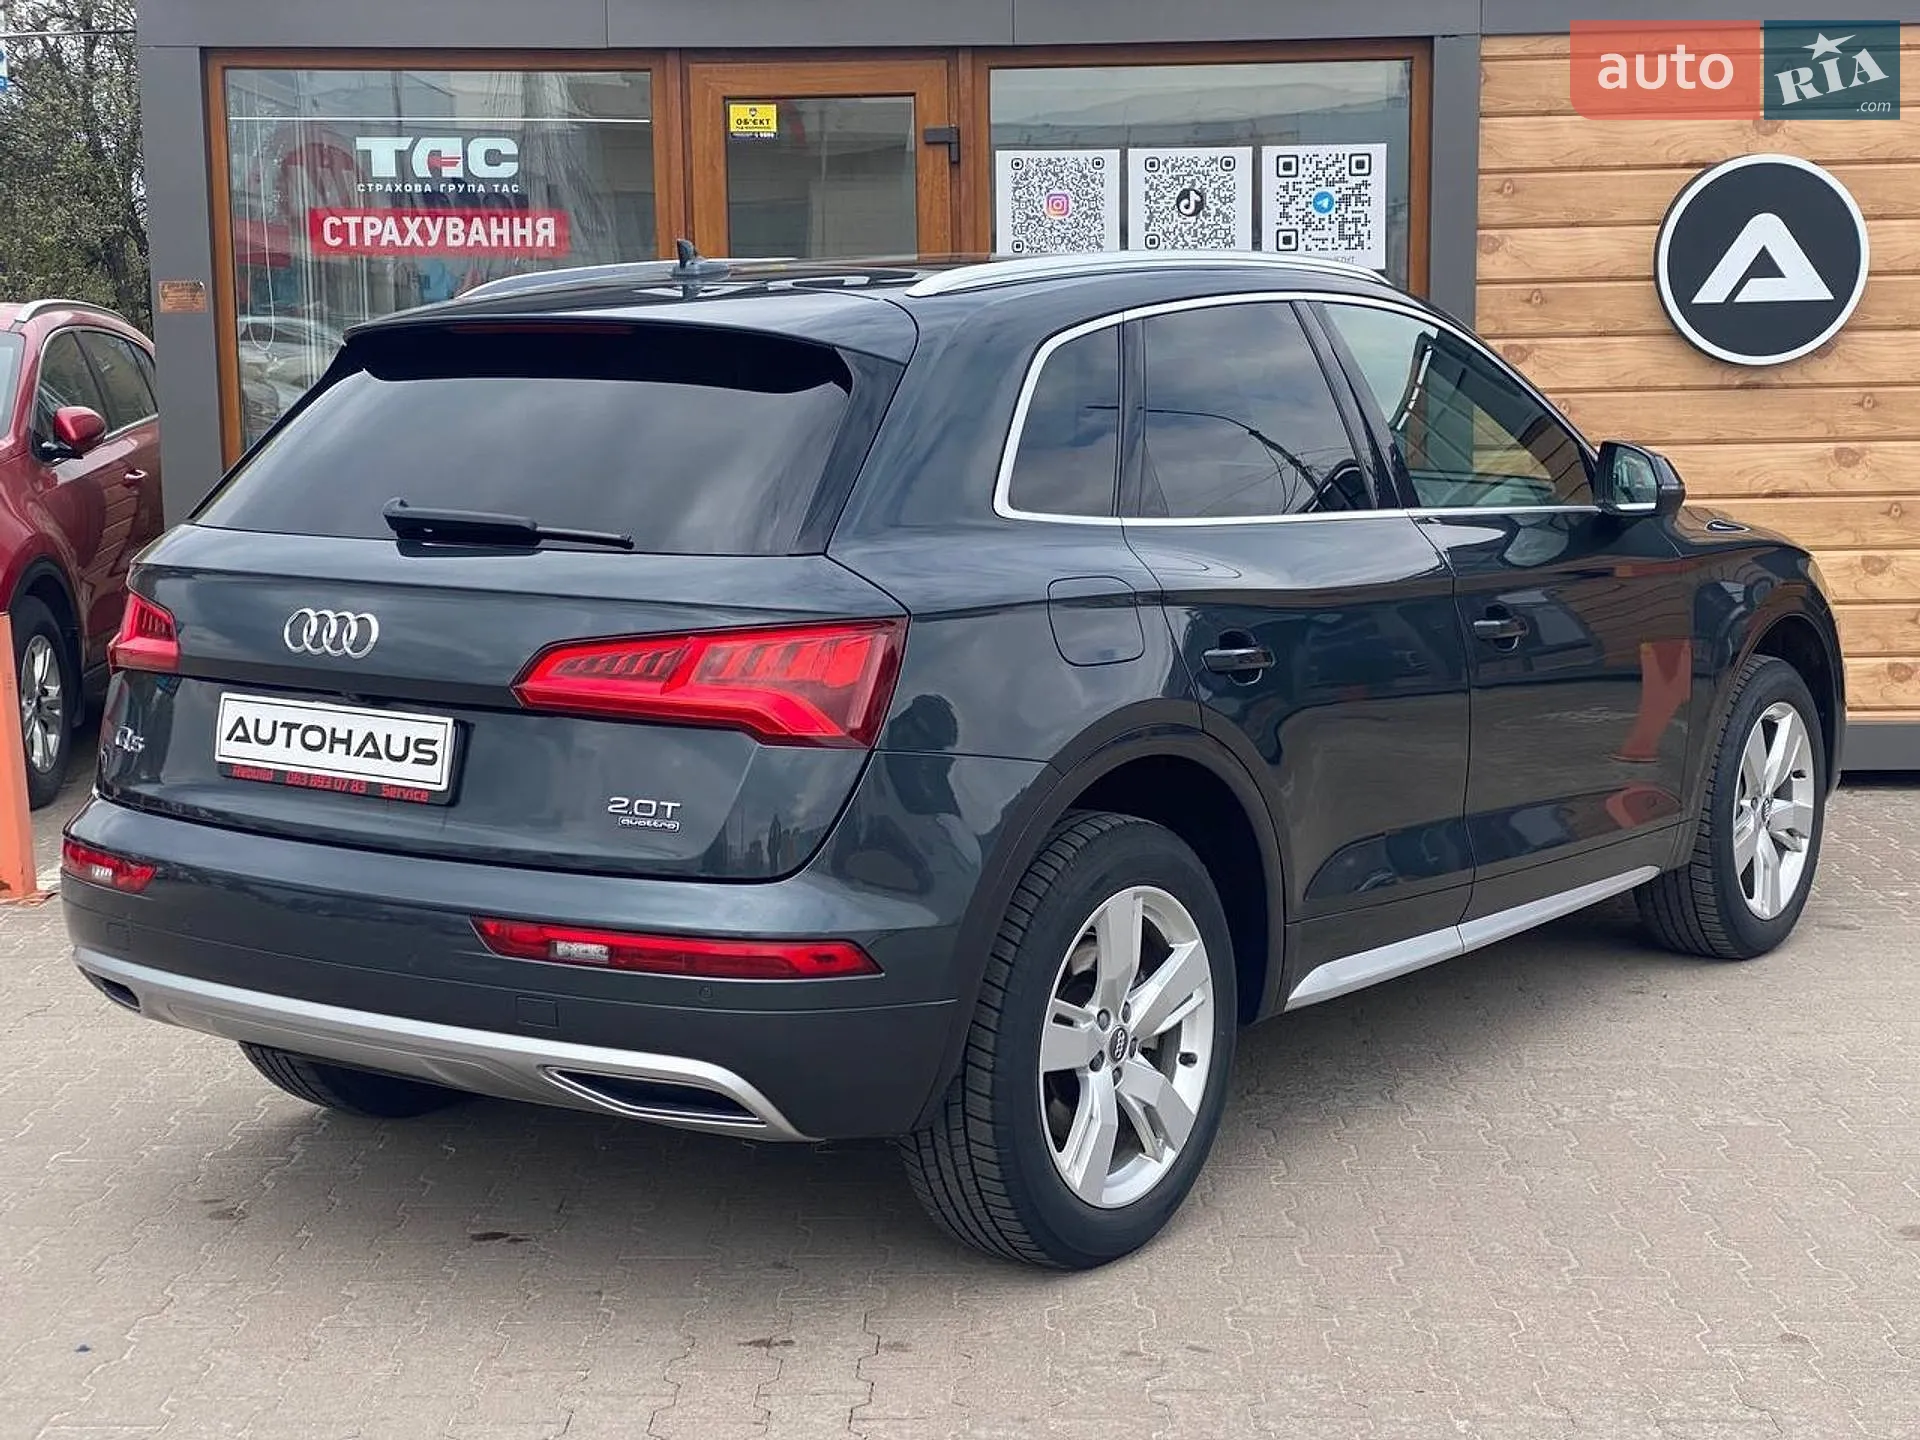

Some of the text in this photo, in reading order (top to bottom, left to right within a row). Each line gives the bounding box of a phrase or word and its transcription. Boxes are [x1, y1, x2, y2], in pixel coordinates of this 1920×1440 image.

[357, 183, 519, 194] СТРАХОВА ГРУПА ТАС
[322, 216, 556, 248] СТРАХУВАННЯ
[225, 716, 438, 766] AUTOHAUS
[382, 784, 430, 801] Service
